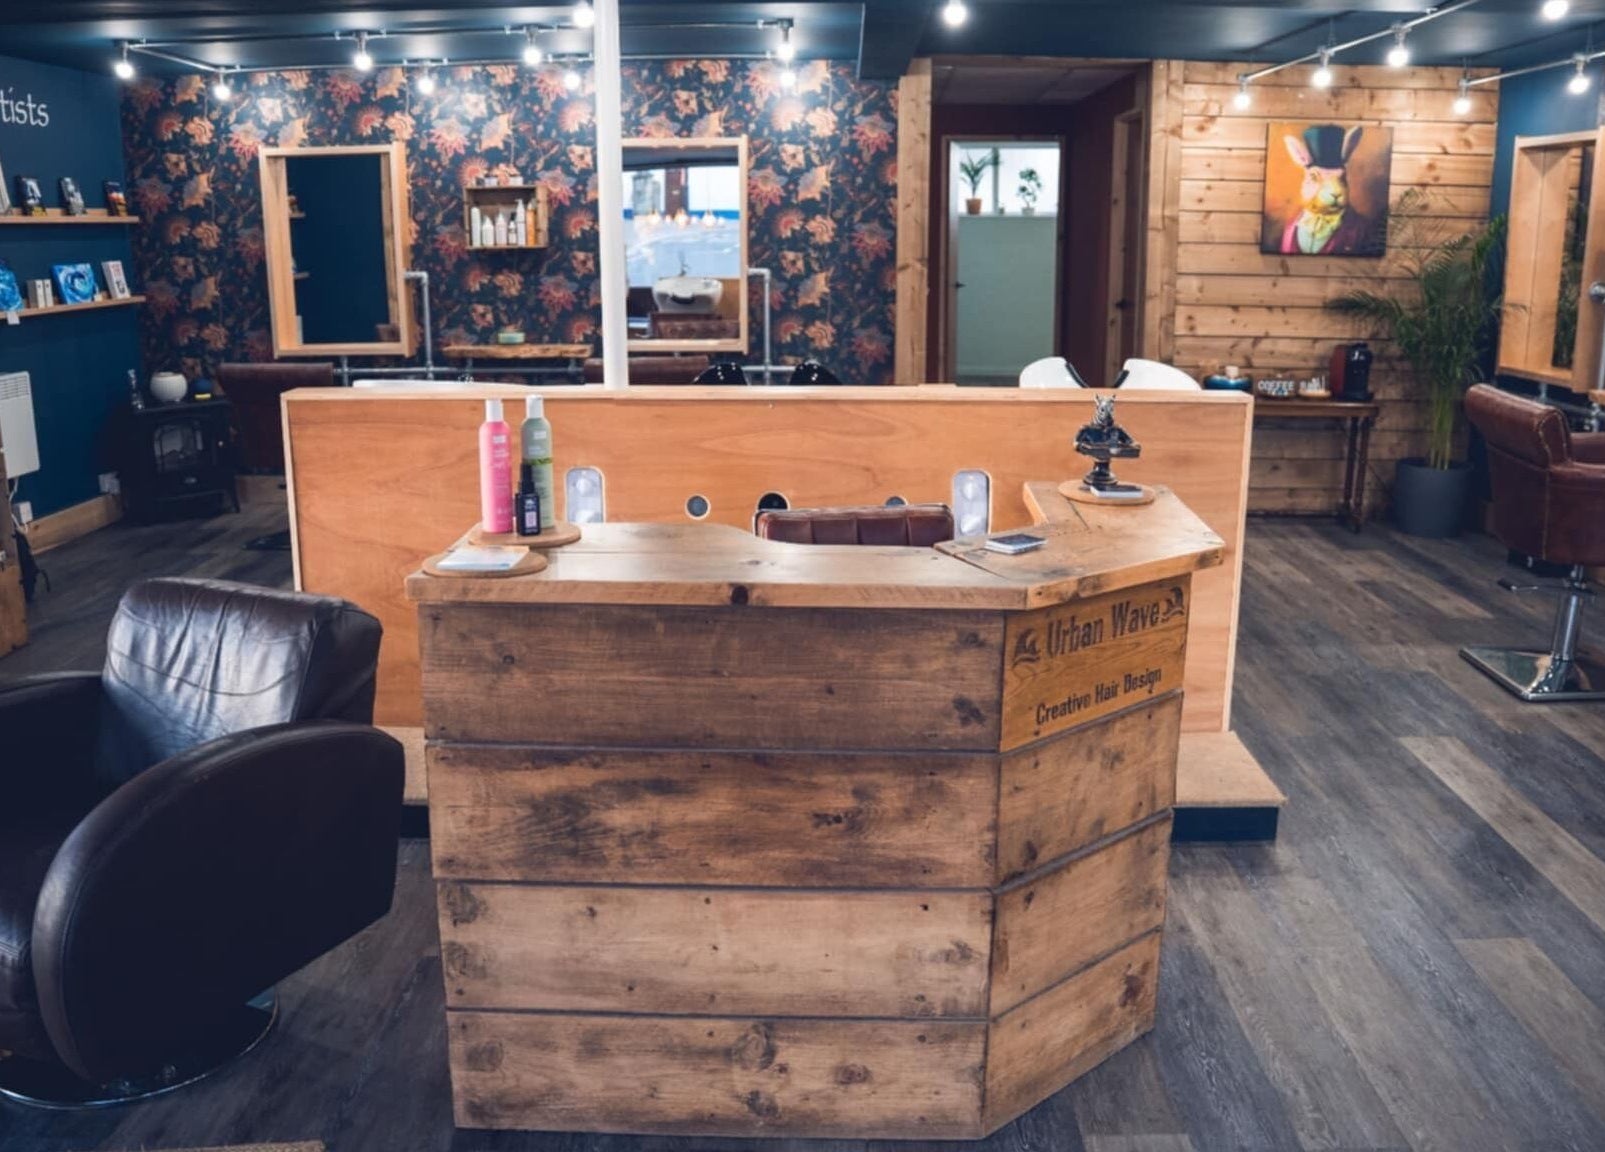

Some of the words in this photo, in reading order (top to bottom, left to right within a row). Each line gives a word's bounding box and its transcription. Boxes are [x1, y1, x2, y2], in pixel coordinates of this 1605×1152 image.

[0, 87, 49, 127] tists
[1258, 380, 1294, 391] COFFEE
[1046, 615, 1104, 657] Urban
[1112, 601, 1160, 639] Wave
[1035, 693, 1091, 726] Creative
[1095, 681, 1119, 705] Hair
[1124, 668, 1162, 694] Design
